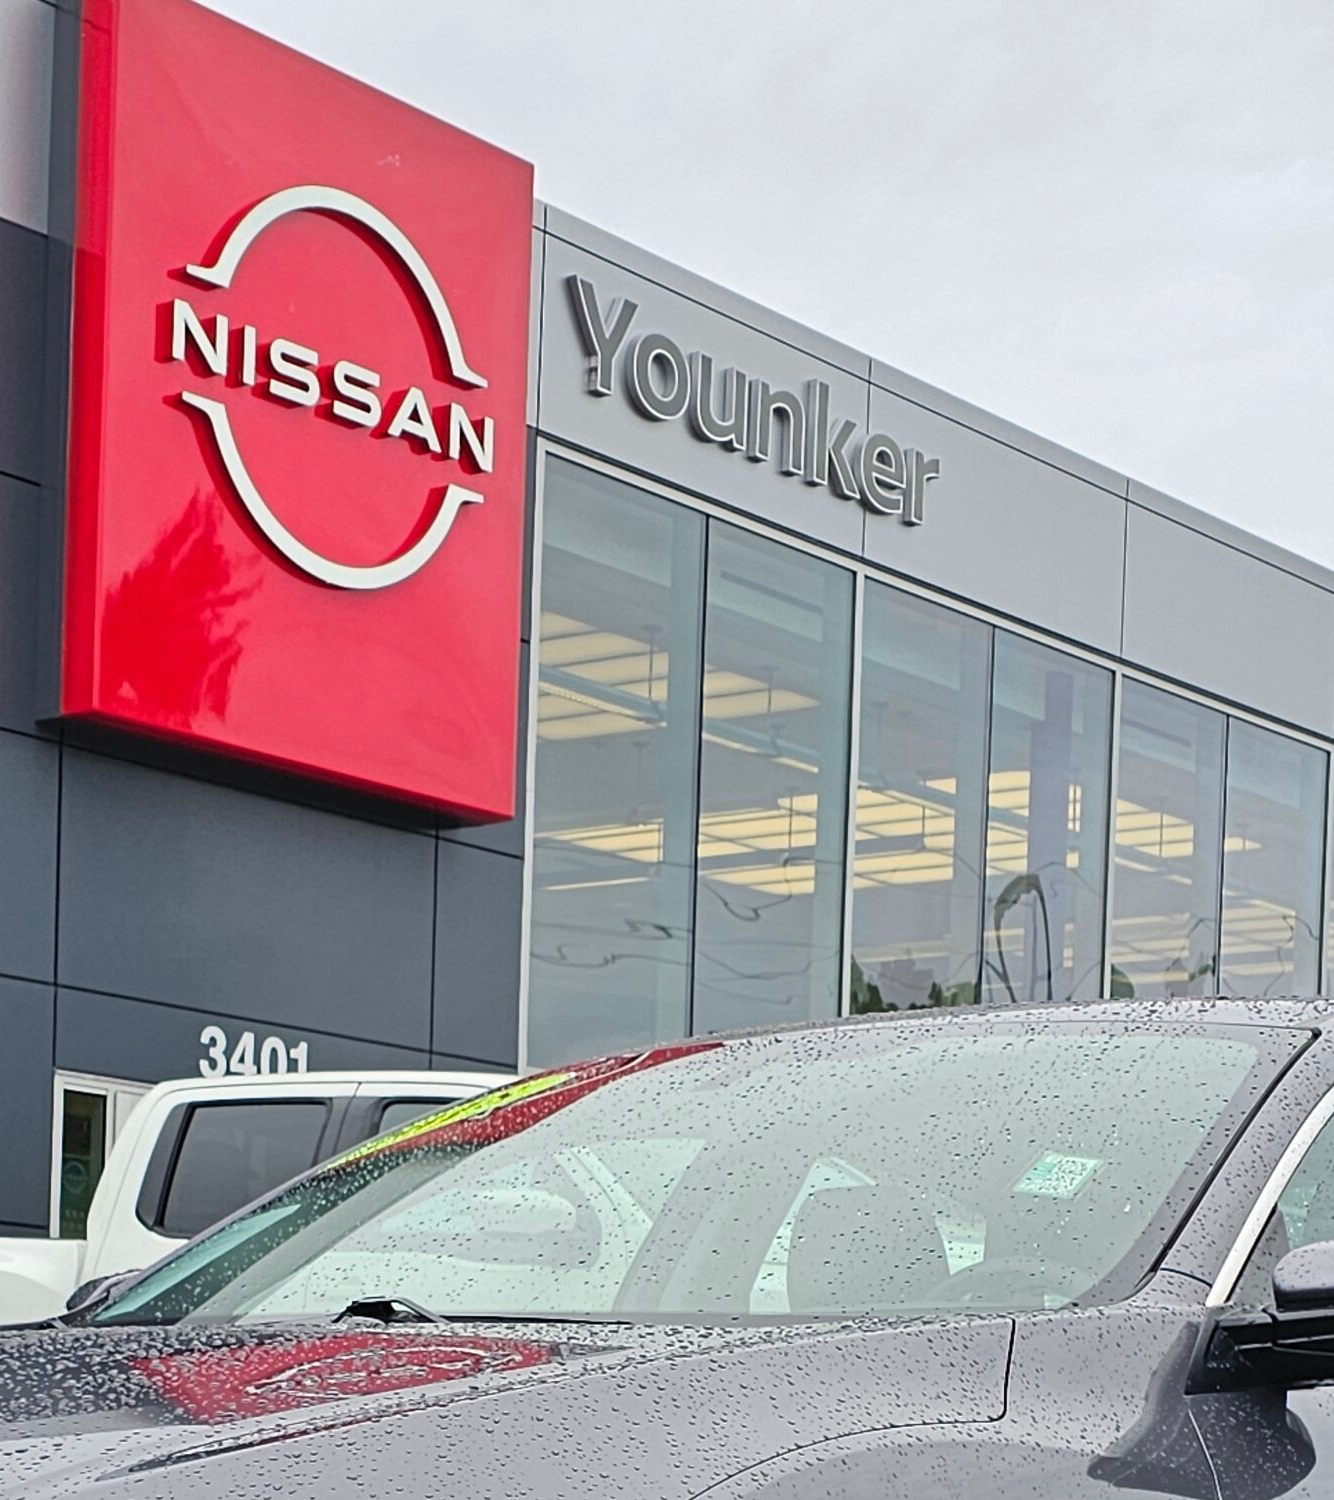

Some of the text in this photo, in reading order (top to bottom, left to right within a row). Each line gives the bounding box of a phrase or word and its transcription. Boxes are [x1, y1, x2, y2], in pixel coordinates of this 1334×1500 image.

[171, 298, 495, 473] NISSAN
[566, 273, 940, 527] Younker
[198, 1025, 310, 1077] 3401
